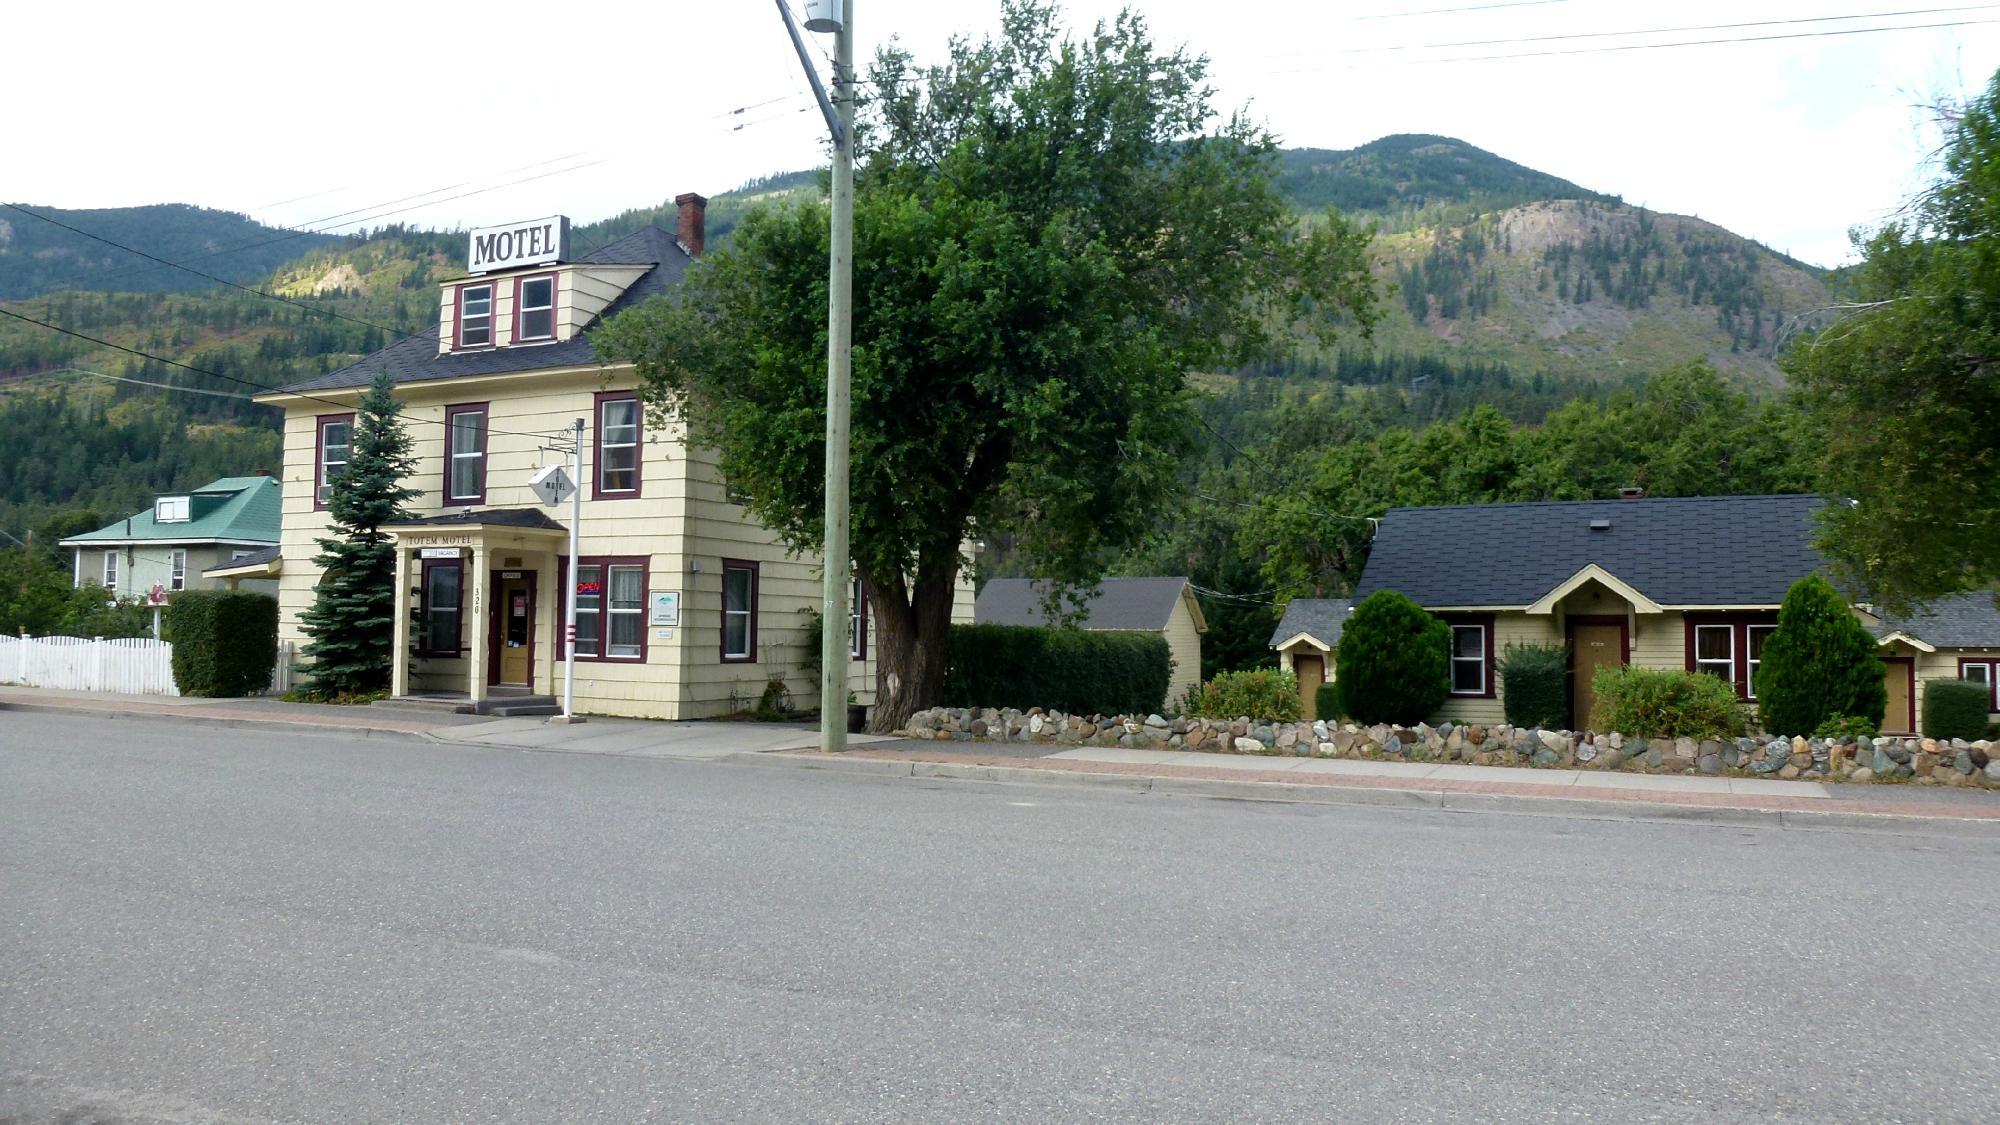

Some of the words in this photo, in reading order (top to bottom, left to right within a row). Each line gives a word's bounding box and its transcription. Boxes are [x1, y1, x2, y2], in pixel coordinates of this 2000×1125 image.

[474, 224, 556, 265] MOTEL
[545, 482, 566, 491] MOTEL
[408, 536, 438, 545] TOTEM
[442, 535, 472, 544] MOTEL
[576, 582, 600, 594] OPEN
